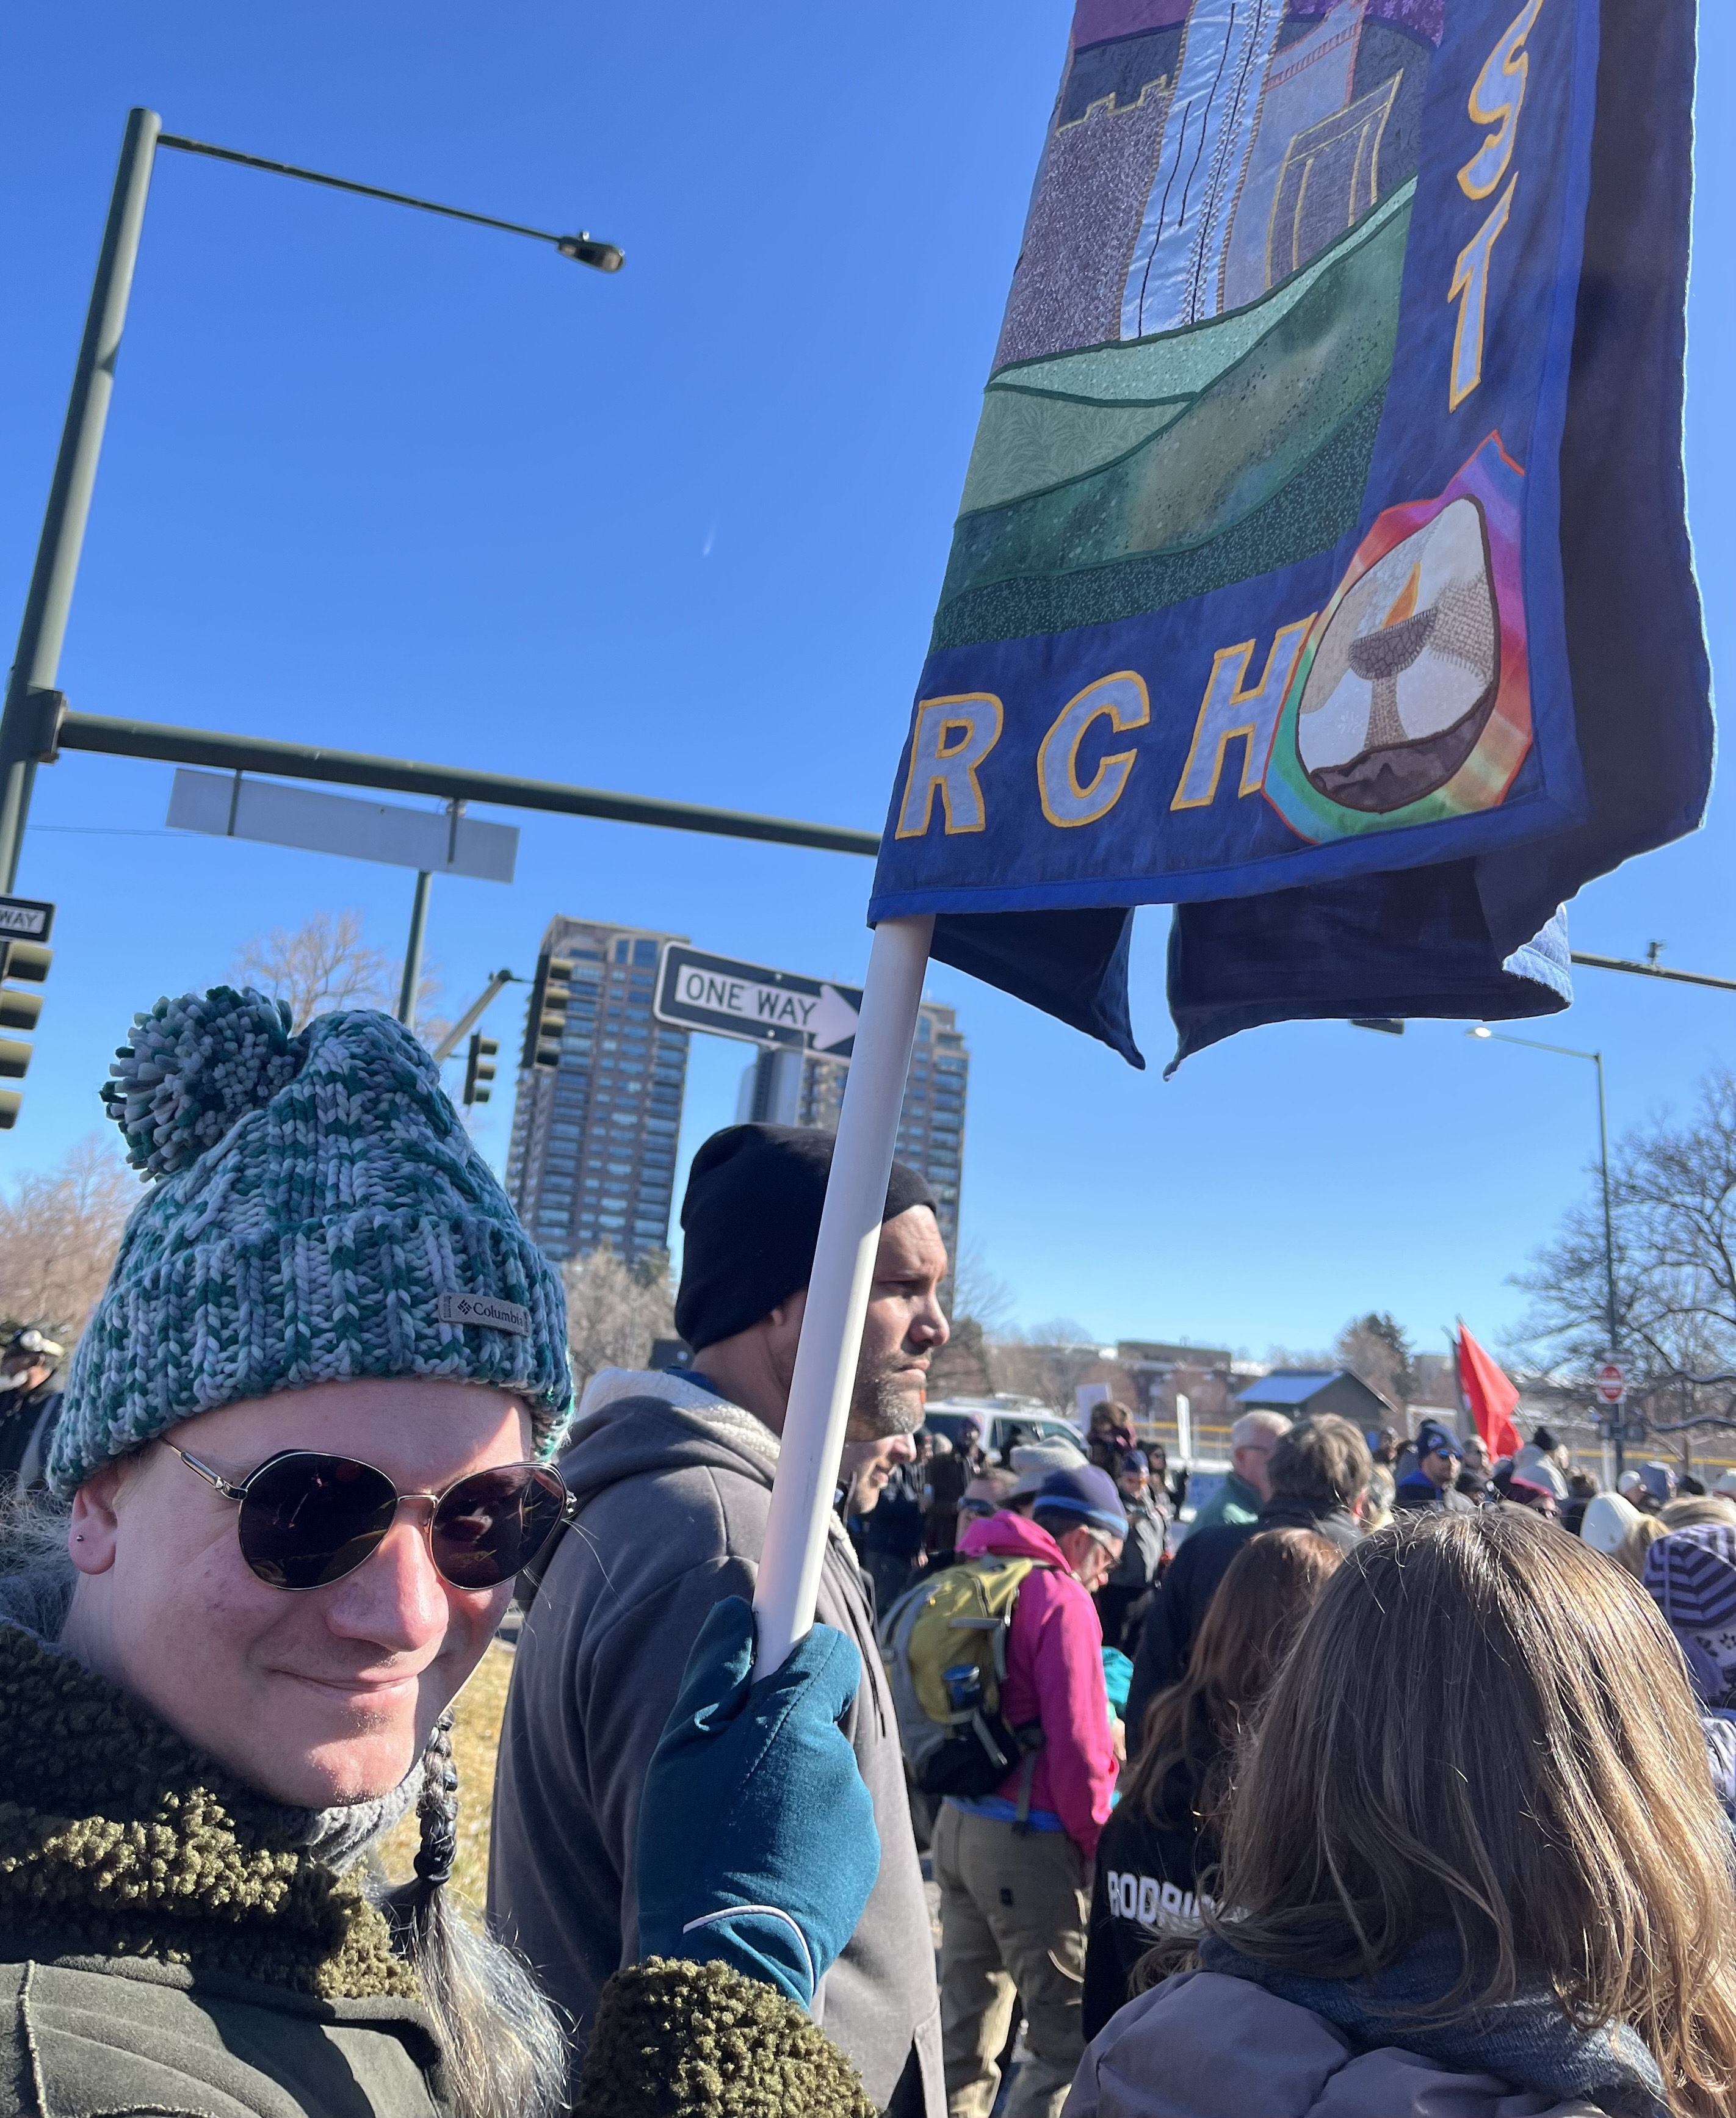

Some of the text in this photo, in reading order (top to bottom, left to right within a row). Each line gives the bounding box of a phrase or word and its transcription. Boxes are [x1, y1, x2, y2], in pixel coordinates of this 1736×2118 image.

[894, 620, 1318, 840] RCH
[686, 972, 818, 1026] ONE WAY
[472, 1301, 524, 1328] Columbia
